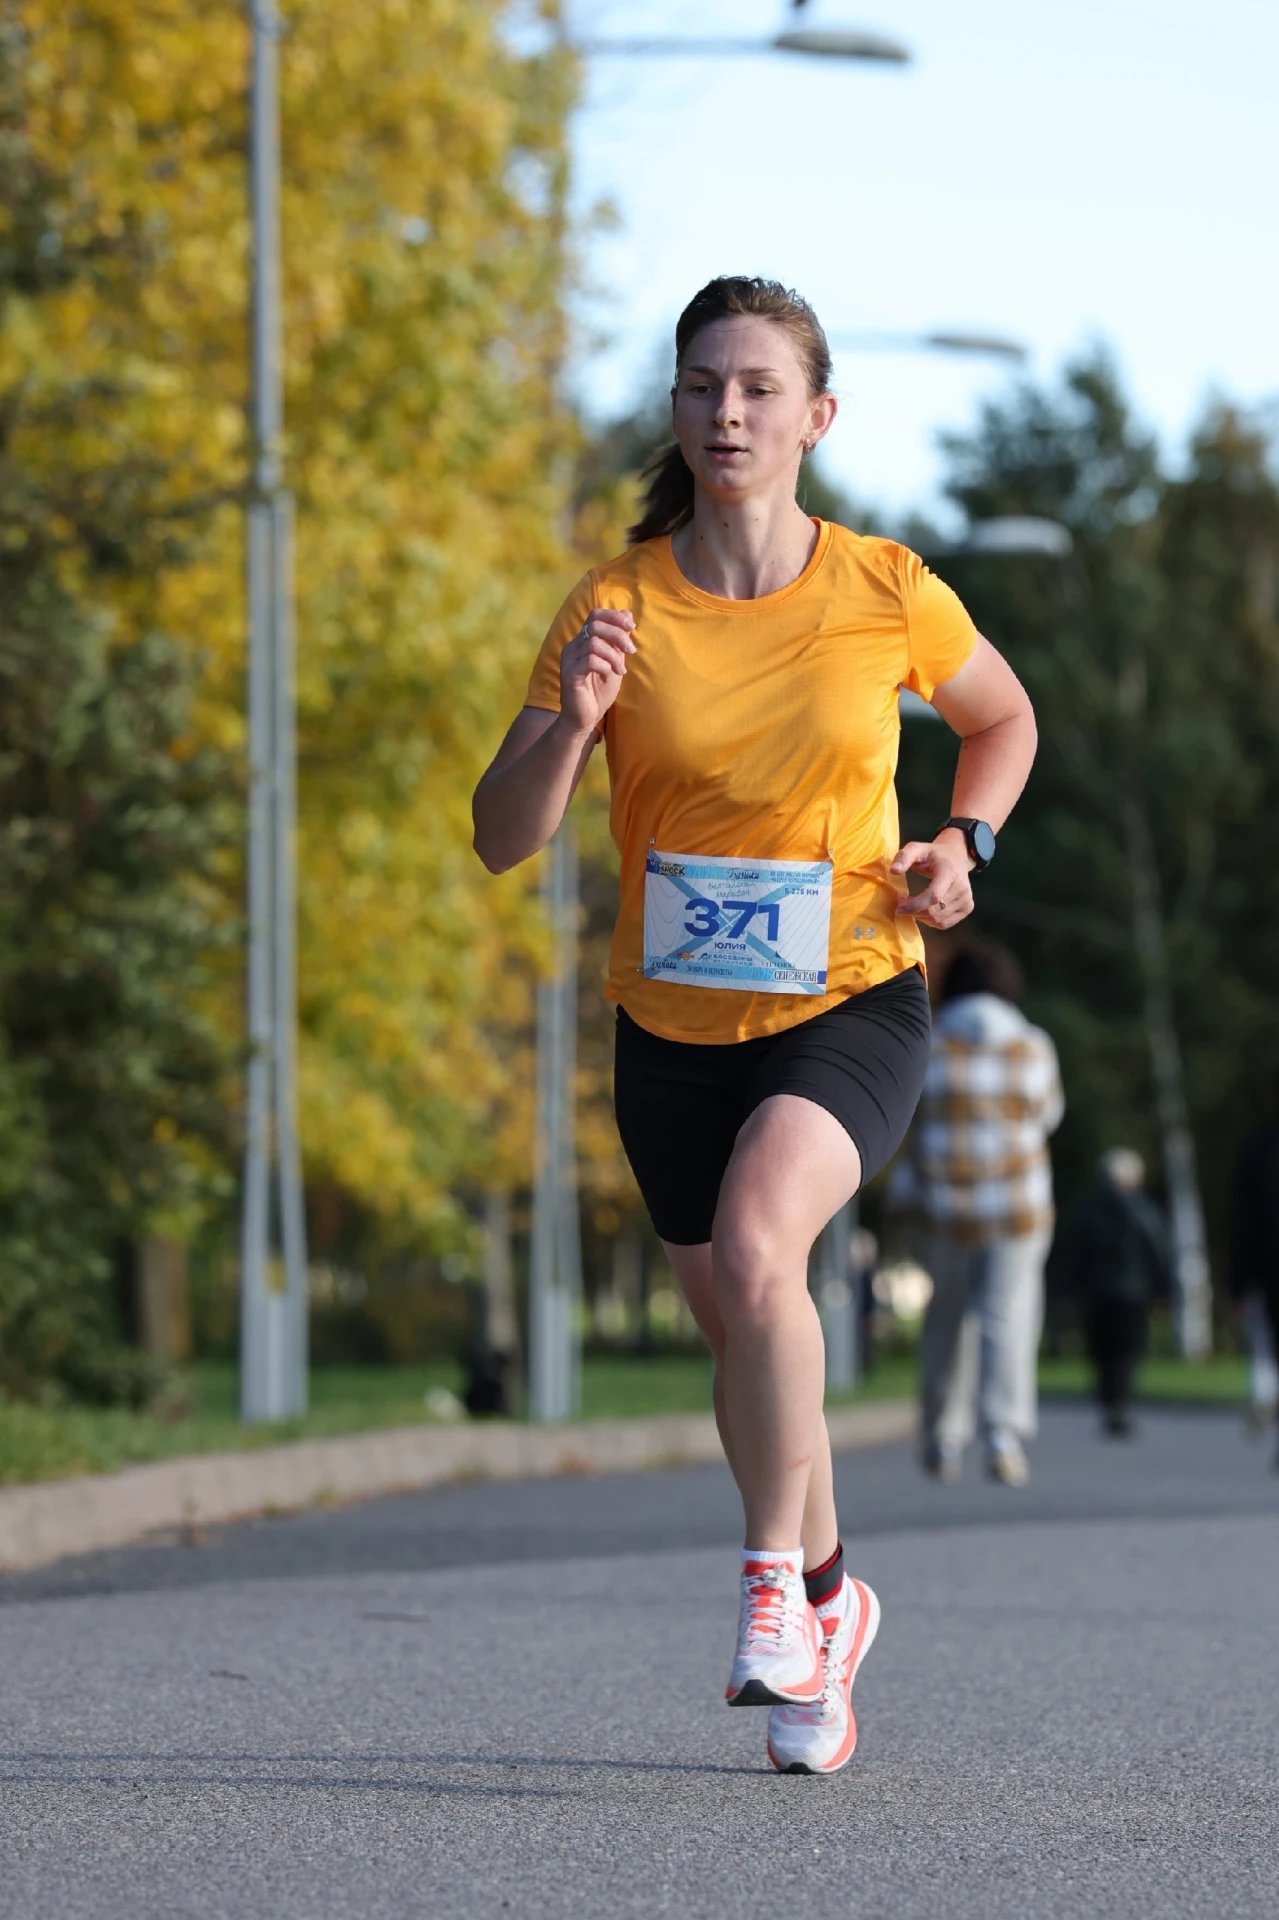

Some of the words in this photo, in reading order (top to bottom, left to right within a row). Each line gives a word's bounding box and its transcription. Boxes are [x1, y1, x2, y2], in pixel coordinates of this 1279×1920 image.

[660, 866, 685, 876] SHOCK
[684, 898, 780, 941] 371
[714, 942, 746, 951] ЮЛИЯ
[774, 970, 817, 981] СЕНЕЖСКАЯ
